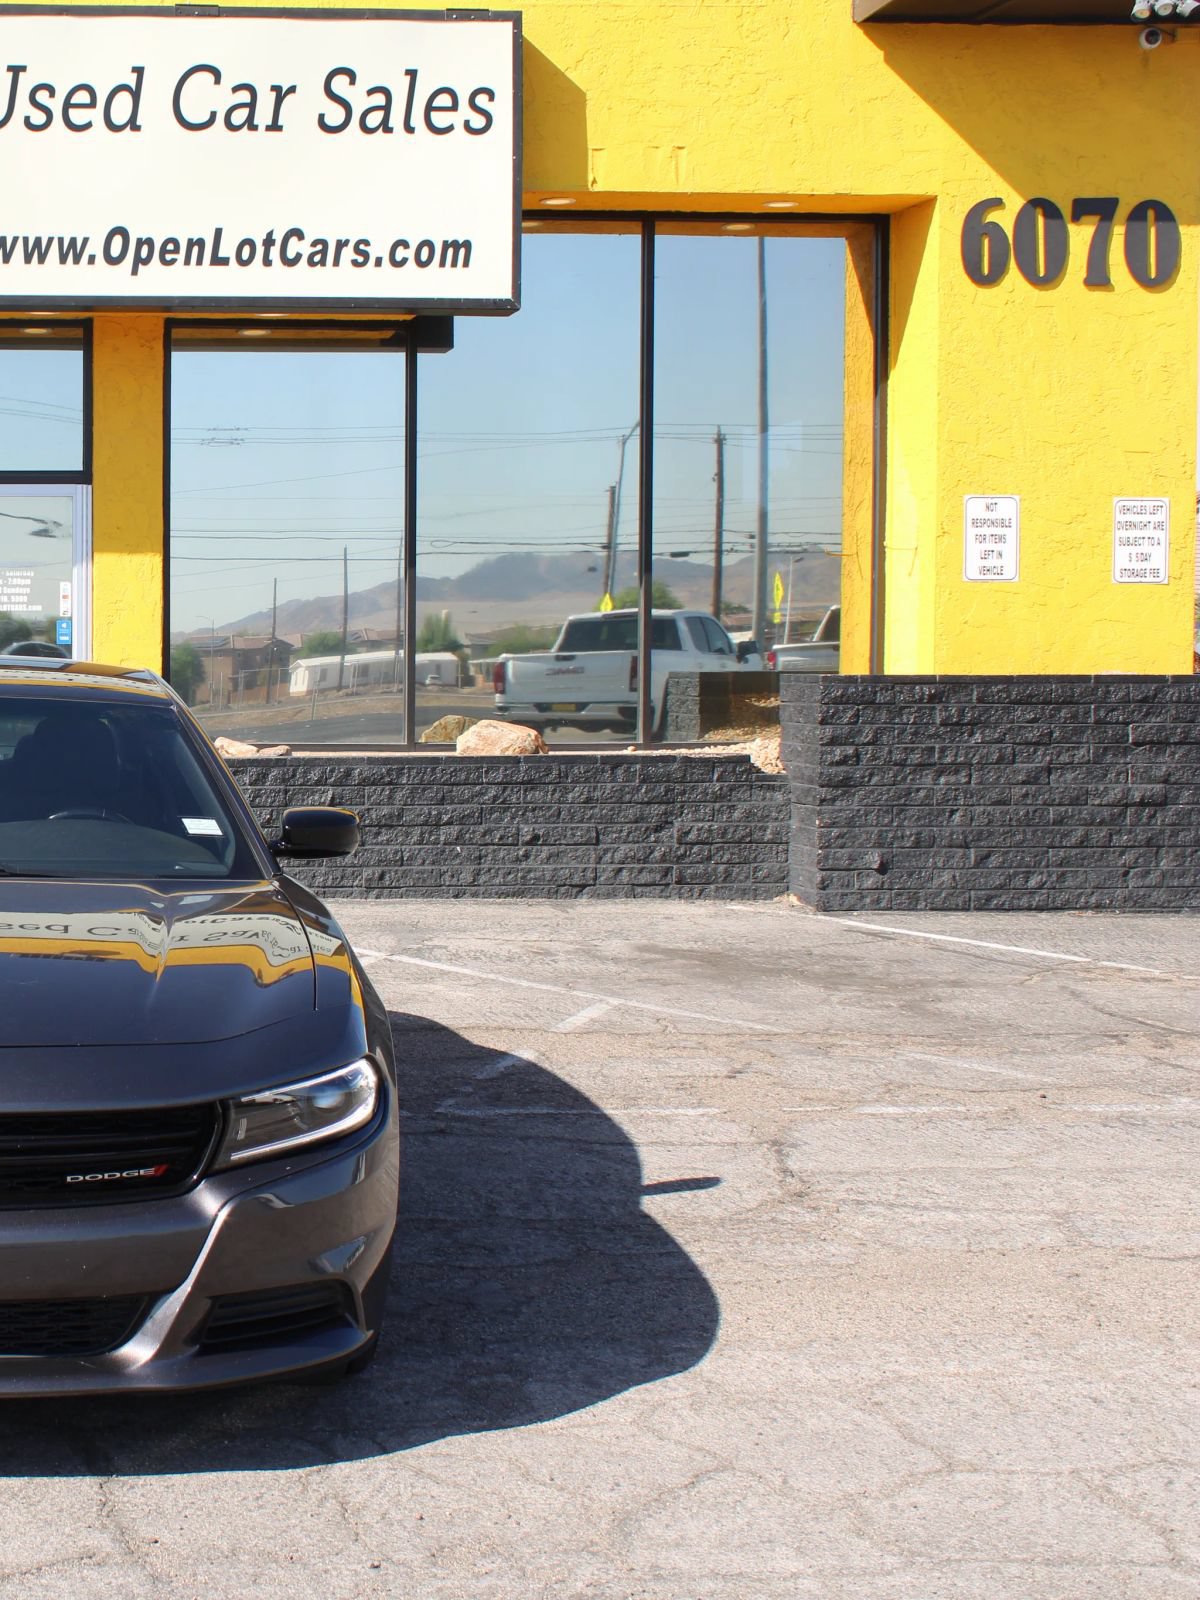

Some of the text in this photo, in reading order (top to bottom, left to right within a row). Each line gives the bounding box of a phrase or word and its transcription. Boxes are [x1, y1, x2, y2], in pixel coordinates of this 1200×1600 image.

[172, 63, 297, 132] Car
[317, 66, 495, 136] Sales
[961, 197, 1181, 289] 6070
[985, 502, 998, 513] NOT
[1118, 505, 1164, 515] VEHICLES LEFT
[971, 518, 1013, 528] RESPONSIBLE
[1116, 521, 1165, 531] OVERNIGHT ARE
[975, 534, 1007, 544] FOR ITEMS
[1118, 537, 1161, 547] SUBJECT TO A
[979, 550, 1003, 560] LEFT IN
[978, 566, 1004, 576] VEHICLE
[1119, 568, 1161, 578] STORAGE FEE
[66, 1168, 155, 1182] DODGE
